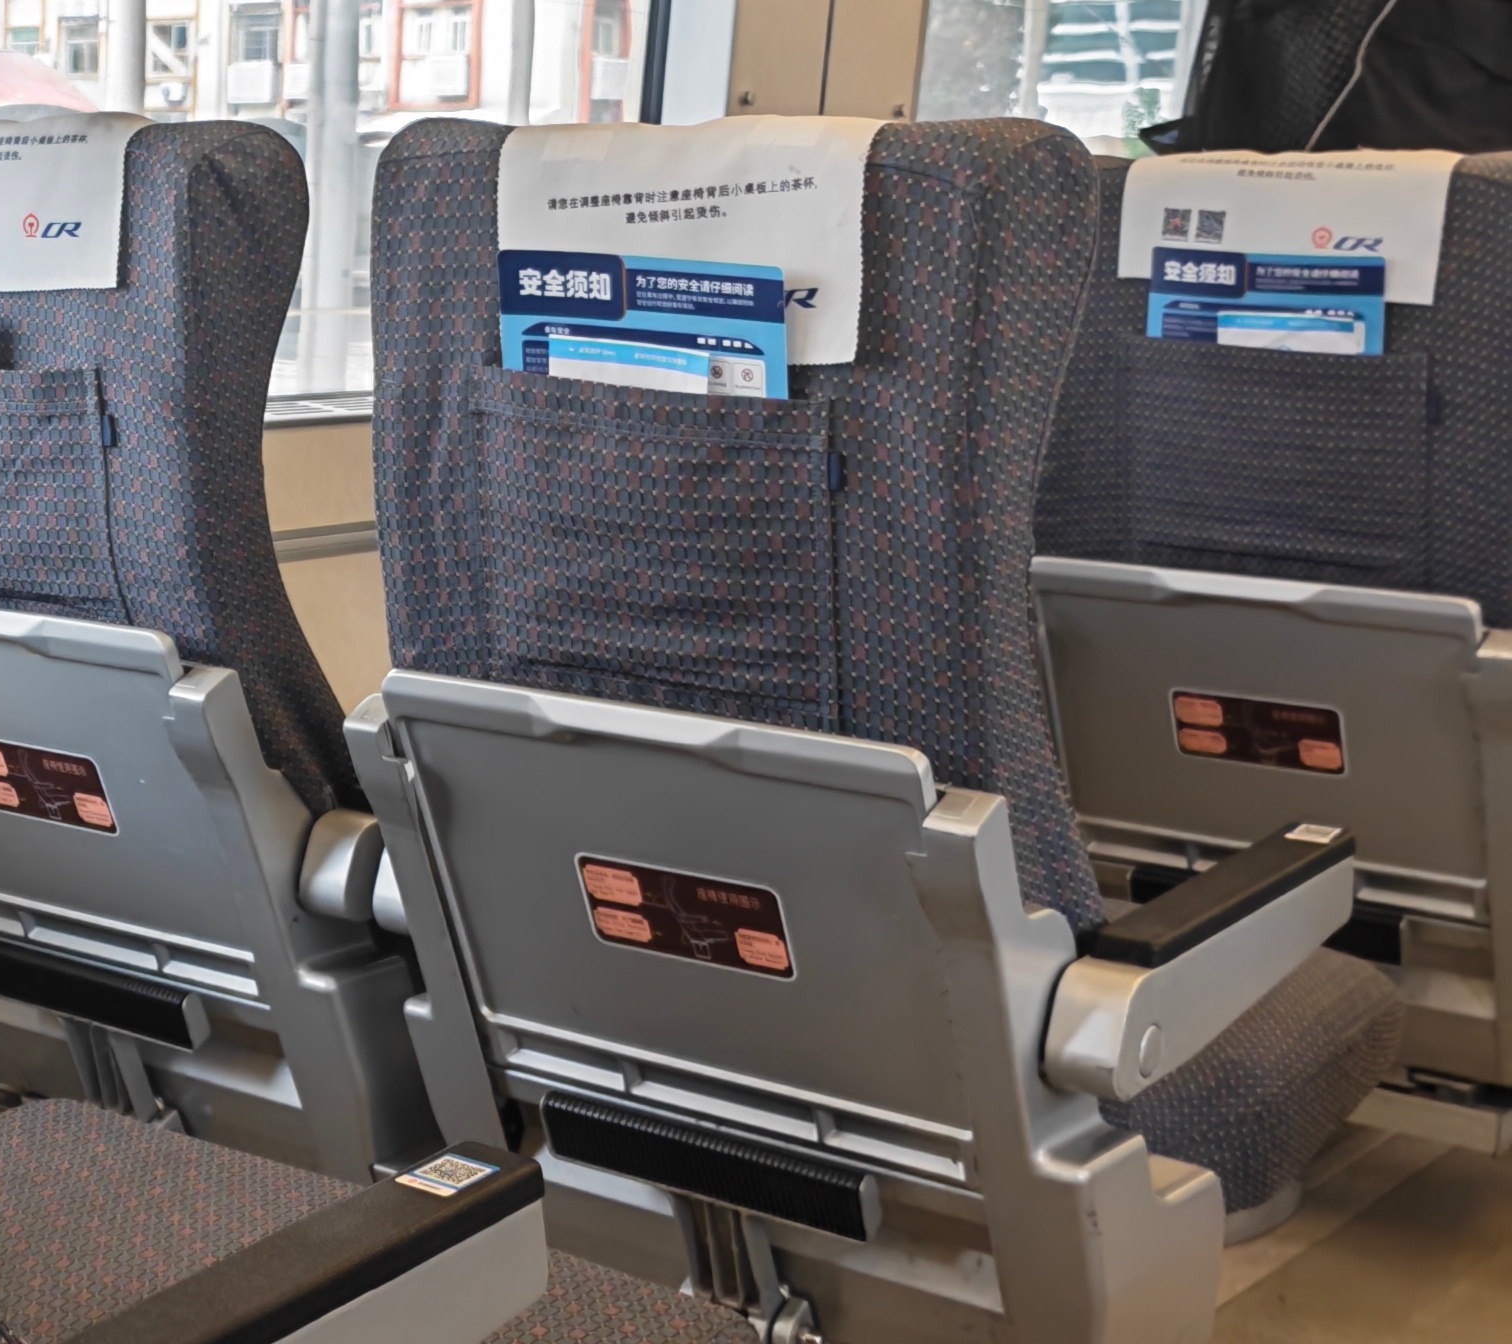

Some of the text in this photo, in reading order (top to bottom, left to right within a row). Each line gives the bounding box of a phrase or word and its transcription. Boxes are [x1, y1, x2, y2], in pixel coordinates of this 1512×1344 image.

[519, 268, 612, 301] 安全须知
[635, 275, 755, 297] 为了您的安全请仔细阅读
[1164, 261, 1236, 286] 安全须知
